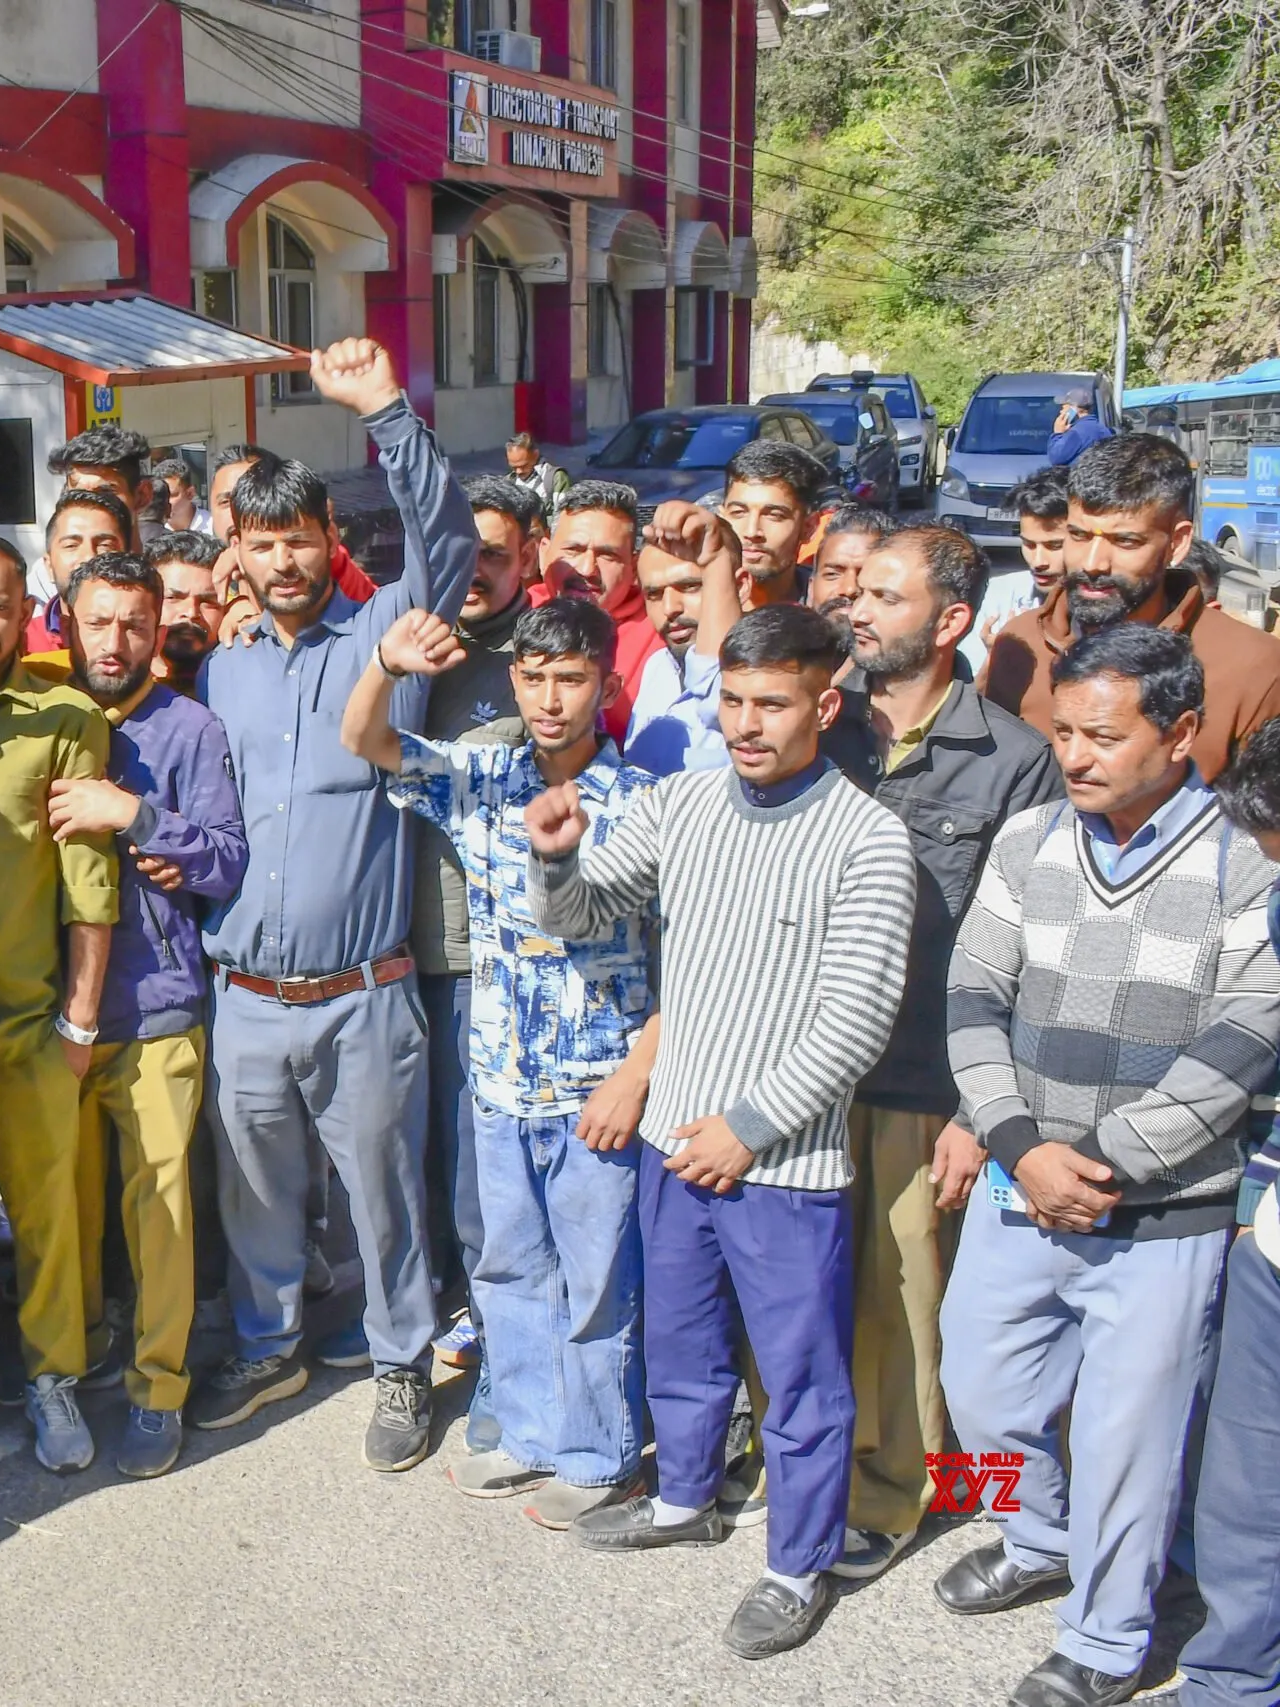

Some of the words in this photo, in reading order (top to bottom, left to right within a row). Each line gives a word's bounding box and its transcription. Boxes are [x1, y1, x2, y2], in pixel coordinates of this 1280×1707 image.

[491, 83, 557, 127] DIRECTORATE
[572, 100, 621, 140] TRANSPORT
[512, 131, 563, 170] HIMACHAL
[564, 140, 604, 177] PRADESH
